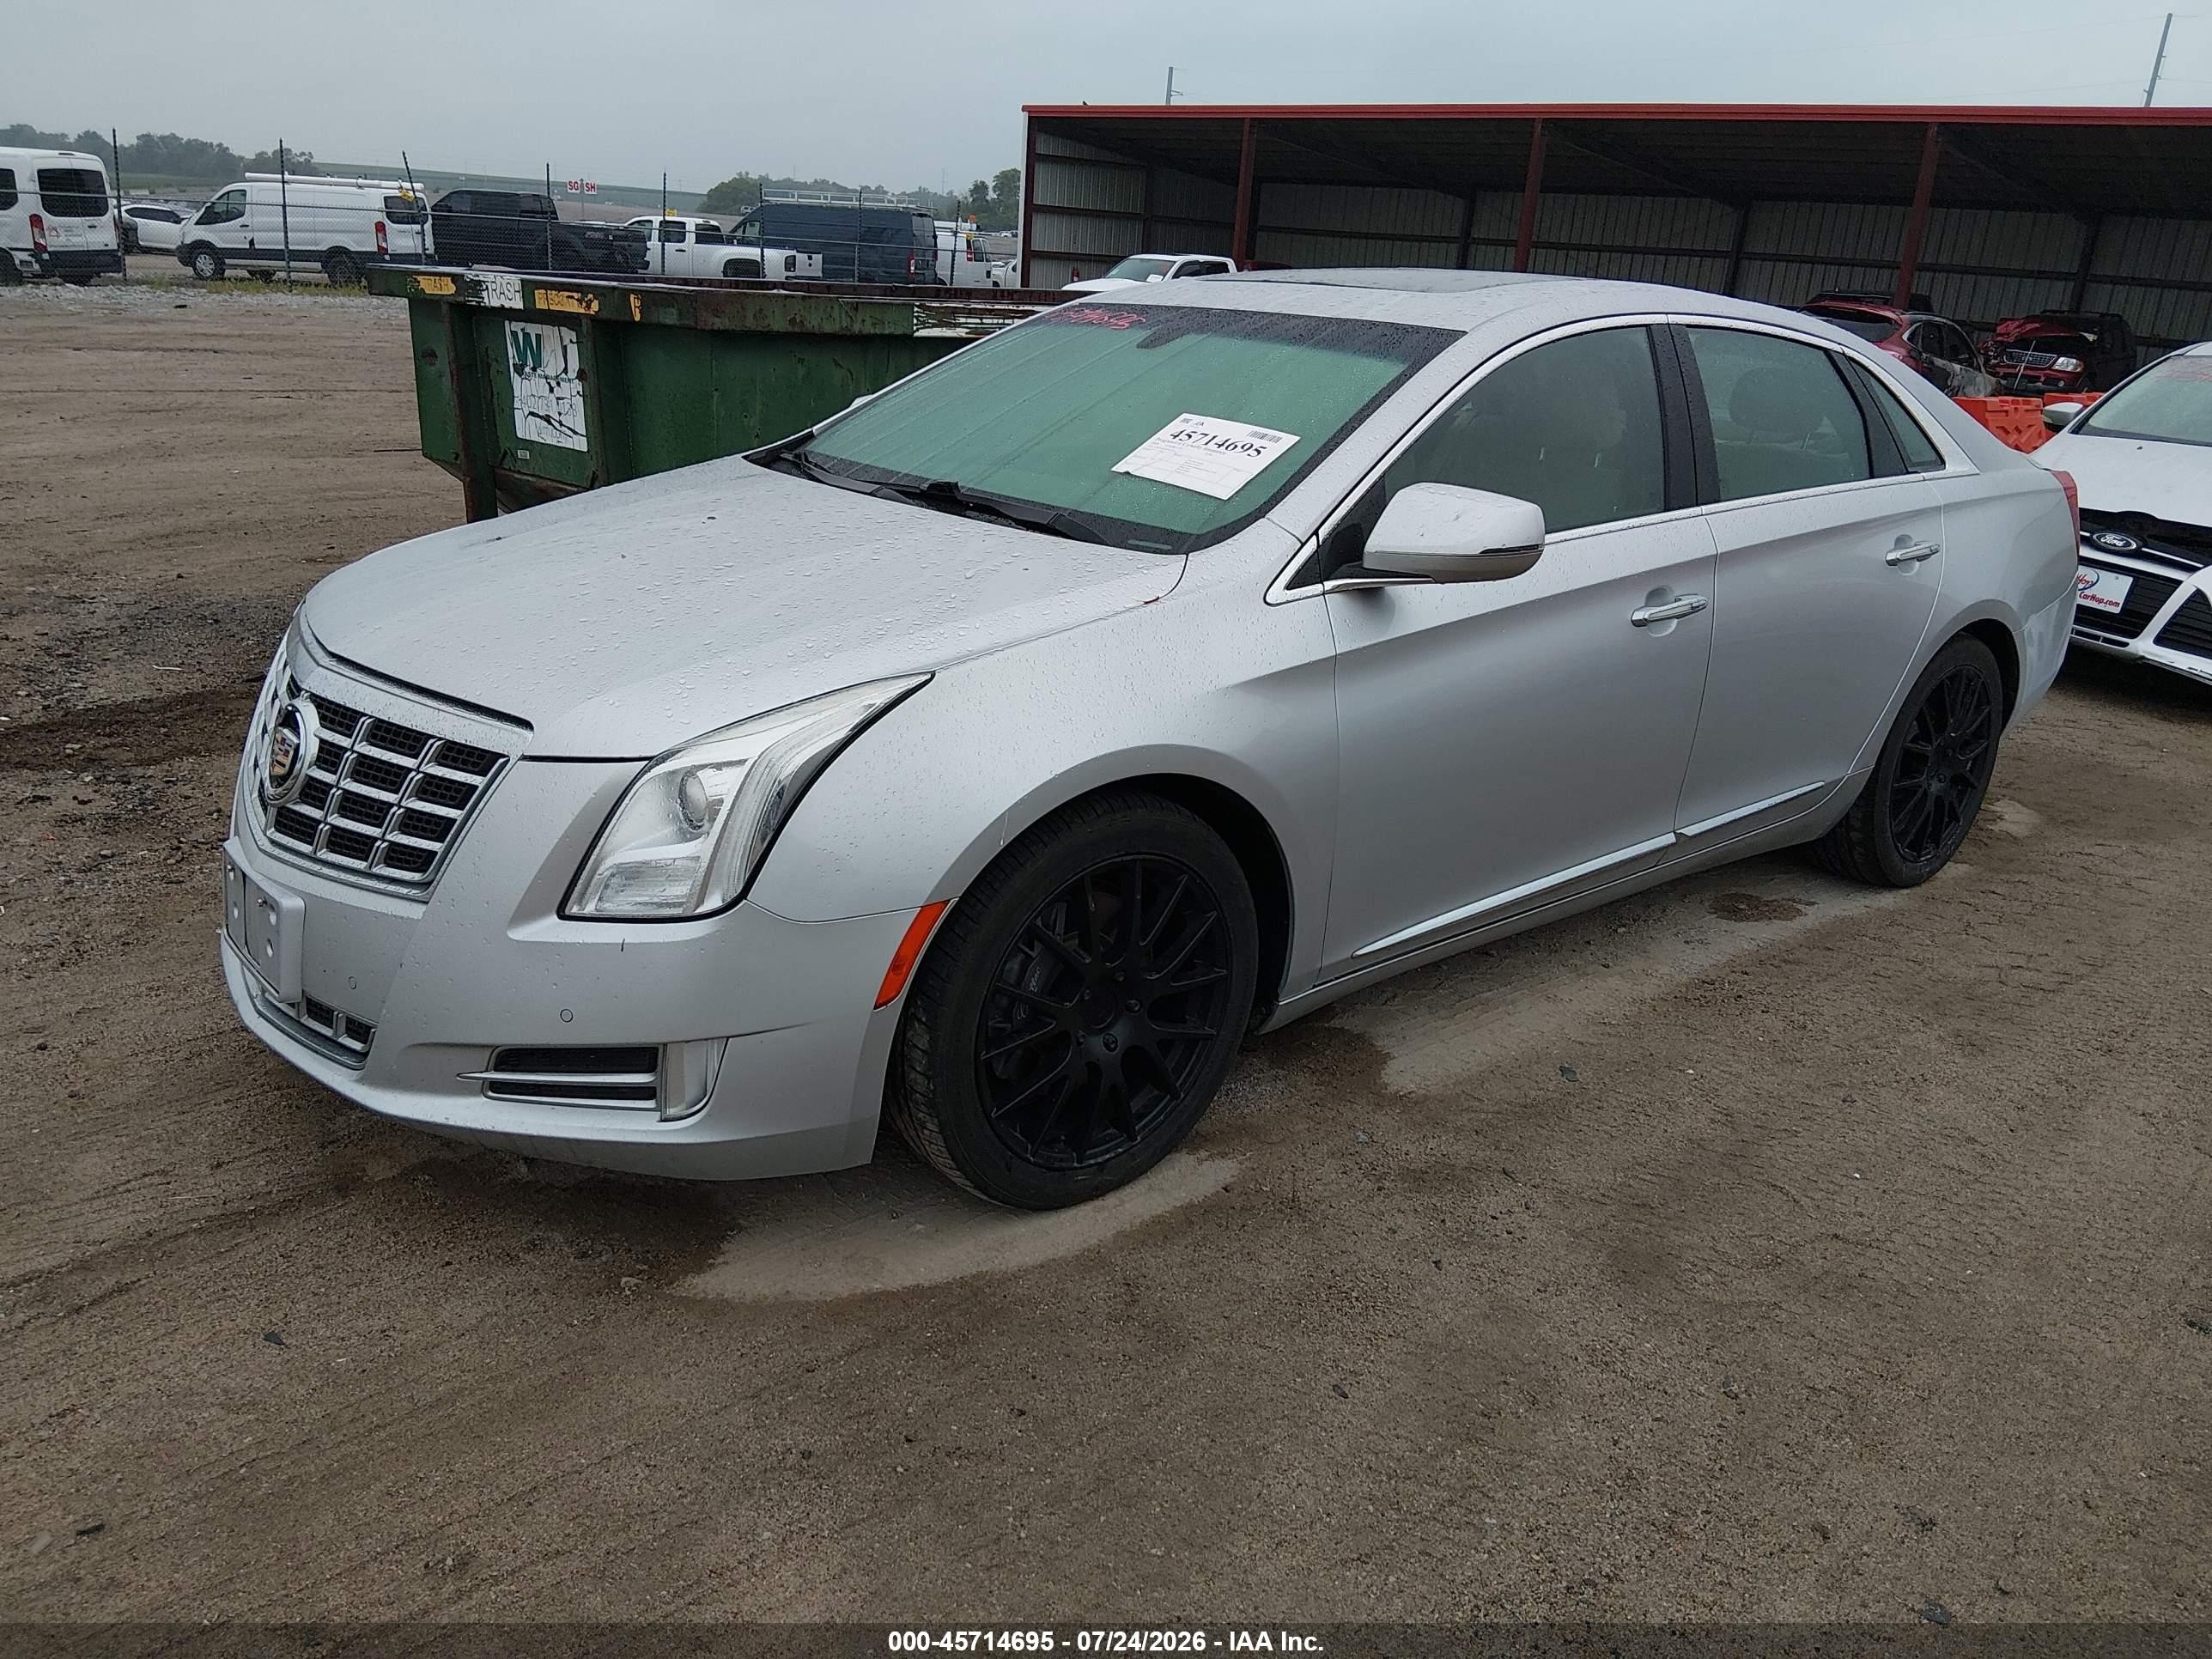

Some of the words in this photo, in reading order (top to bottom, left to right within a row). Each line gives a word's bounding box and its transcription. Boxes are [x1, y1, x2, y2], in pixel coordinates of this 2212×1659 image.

[568, 180, 580, 191] SG
[585, 182, 596, 192] SH
[1169, 429, 1268, 457] 45714695
[2100, 534, 2126, 546] Ford
[2079, 592, 2120, 607] CarHop.com
